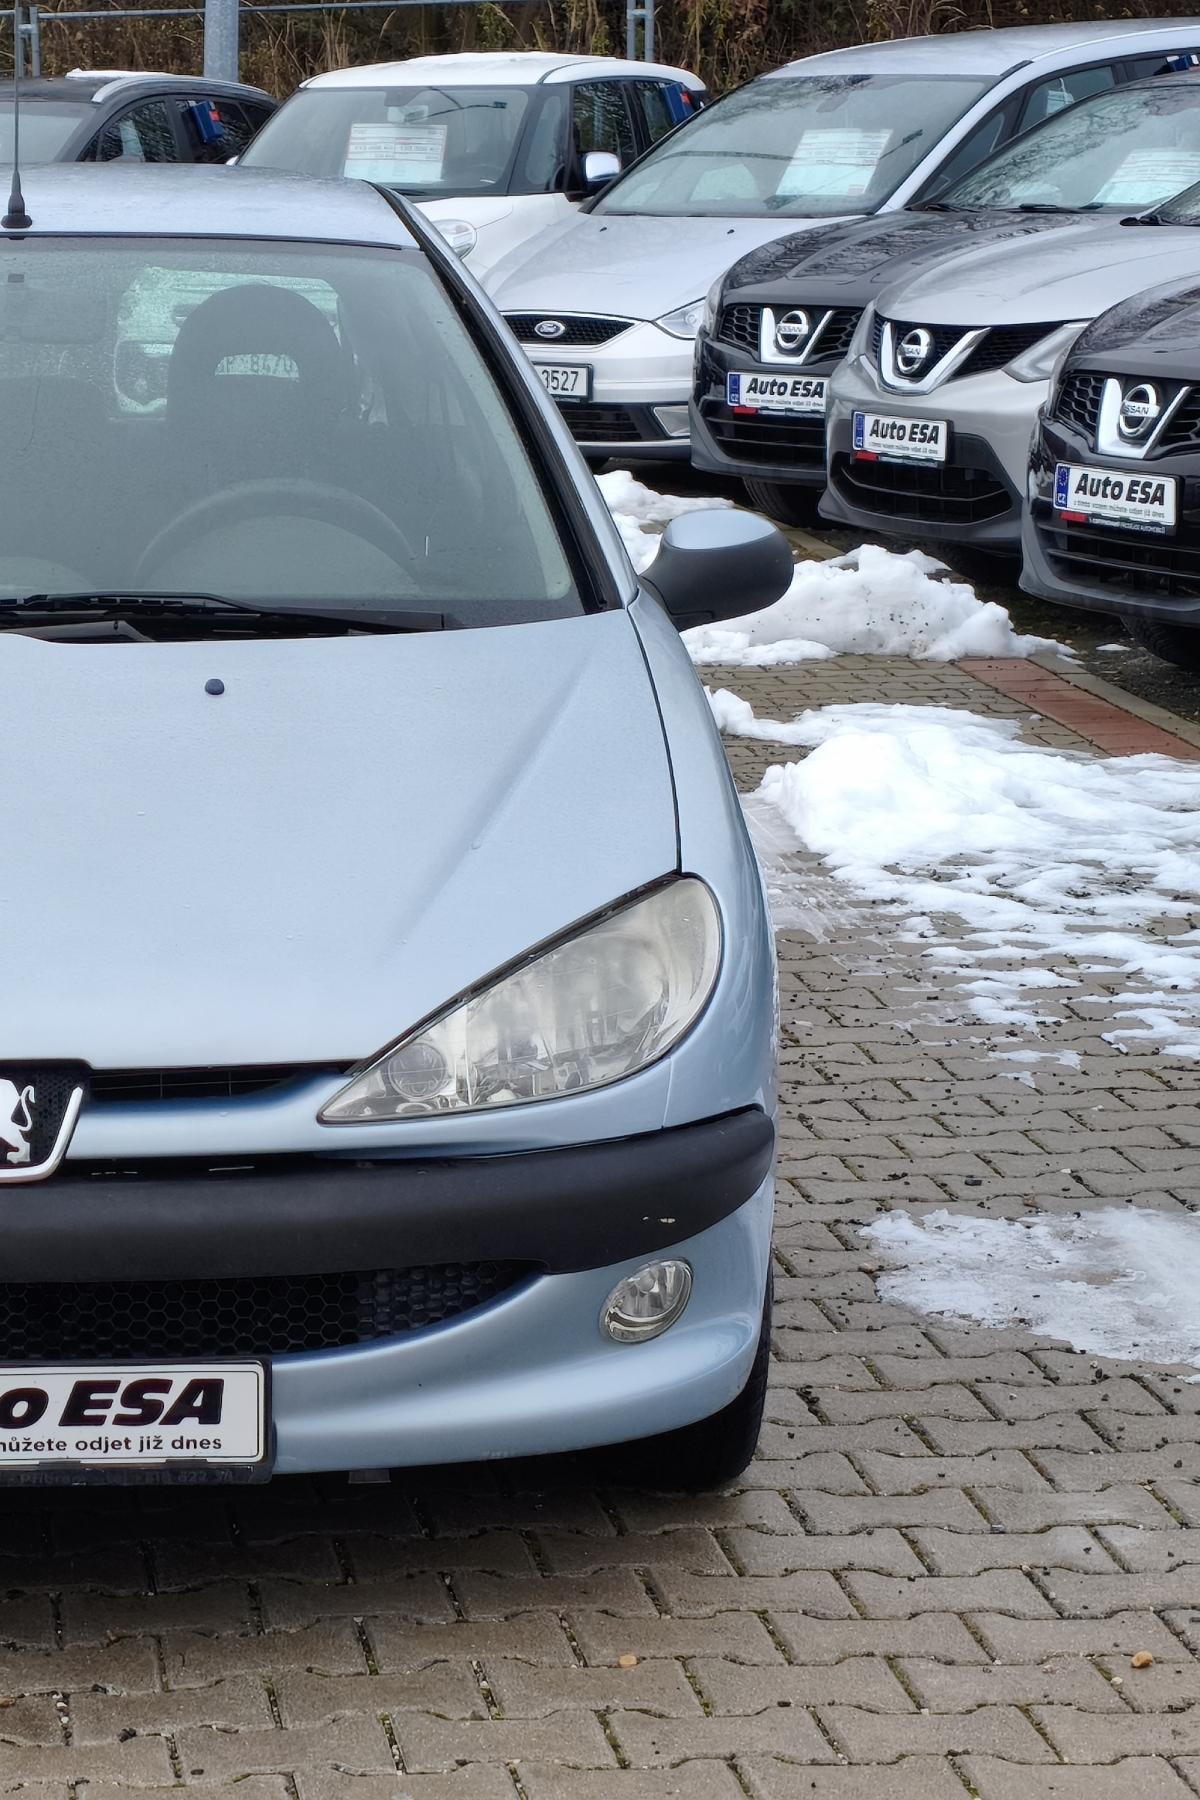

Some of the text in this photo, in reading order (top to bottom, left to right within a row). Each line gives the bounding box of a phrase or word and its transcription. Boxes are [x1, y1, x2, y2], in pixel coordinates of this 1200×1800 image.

[745, 377, 824, 399] Auto ESA
[869, 418, 940, 445] Auto ESA
[1074, 473, 1166, 506] Auto ESA
[58, 1378, 225, 1427] ESA
[75, 1436, 132, 1454] odjet
[138, 1435, 164, 1454] již
[171, 1434, 223, 1450] dnes
